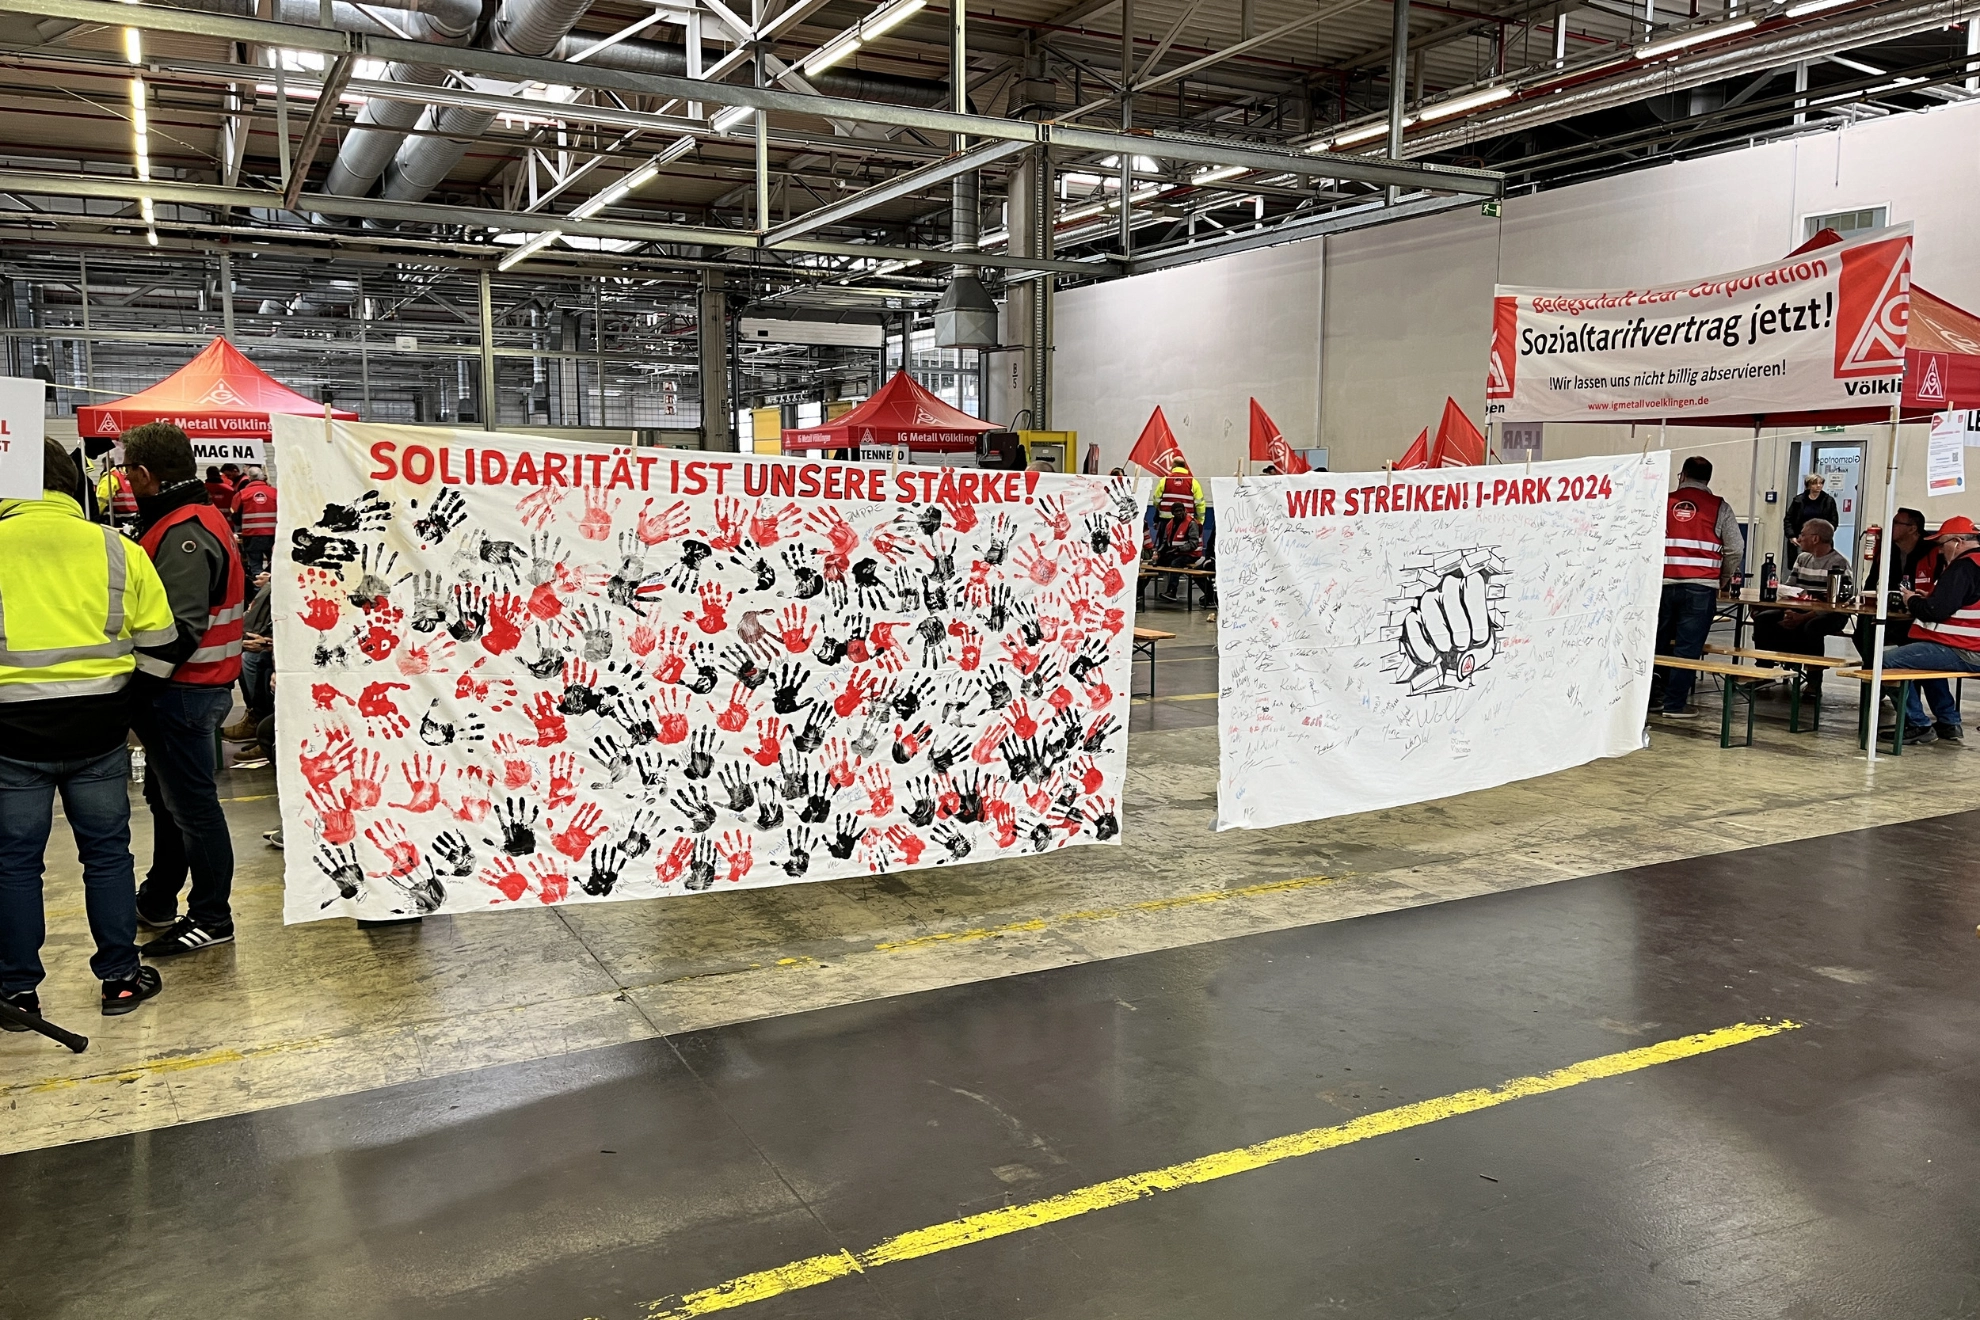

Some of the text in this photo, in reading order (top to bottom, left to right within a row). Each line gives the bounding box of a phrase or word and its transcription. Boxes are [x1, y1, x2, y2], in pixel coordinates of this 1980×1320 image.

[1532, 291, 1636, 315] Belegschaft
[1521, 292, 1832, 356] Sozialtarifvertrag jetzt!
[1550, 359, 1786, 390] !Wir lassen uns nicht billig abservieren!
[1587, 396, 1709, 411] www.igmetallvoelklingen.de
[174, 417, 218, 430] Metall
[897, 432, 908, 442] IG
[909, 432, 938, 442] Metall
[861, 449, 905, 461] TENNEO
[369, 440, 1041, 505] SOLIDARITÄT IST UNSERE STÄRKE!
[1286, 474, 1612, 519] WIR STREIKEN! I-PARK 2024
